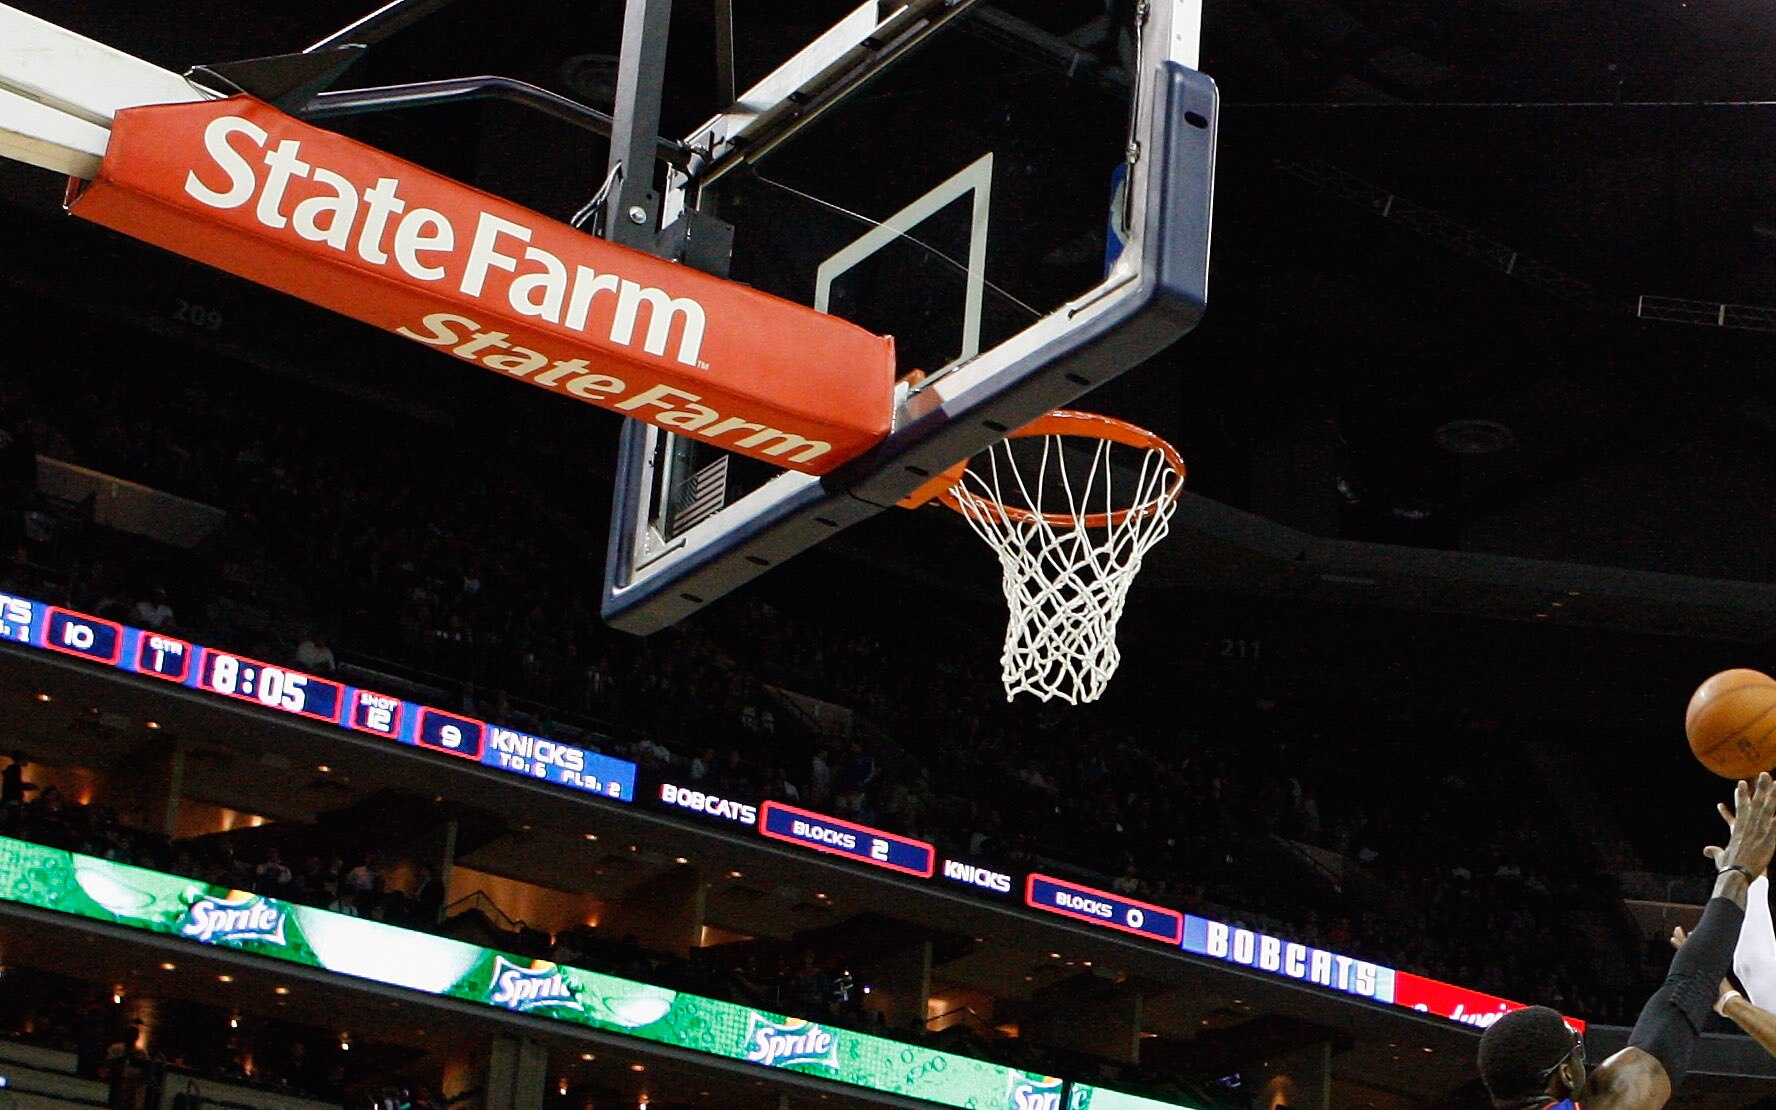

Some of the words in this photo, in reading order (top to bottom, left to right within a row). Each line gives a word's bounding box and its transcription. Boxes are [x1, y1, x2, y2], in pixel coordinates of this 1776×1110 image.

[184, 115, 455, 281] State
[460, 209, 706, 368] Farm
[396, 313, 625, 402] State
[624, 383, 832, 467] Farm
[63, 621, 94, 650] 10
[211, 653, 308, 713] 8:05
[360, 693, 398, 712] SHOT
[441, 725, 462, 748] 9
[492, 727, 585, 772] KNICKS
[660, 783, 757, 824] BOBCATS
[791, 820, 857, 850] BLOCKS
[871, 838, 890, 862] 2
[944, 860, 1012, 893] KNICKS
[181, 899, 279, 941] Sprite
[1055, 891, 1113, 919] BLOCKS
[1206, 920, 1377, 997] BOBCATS
[748, 1027, 831, 1067] Sprite
